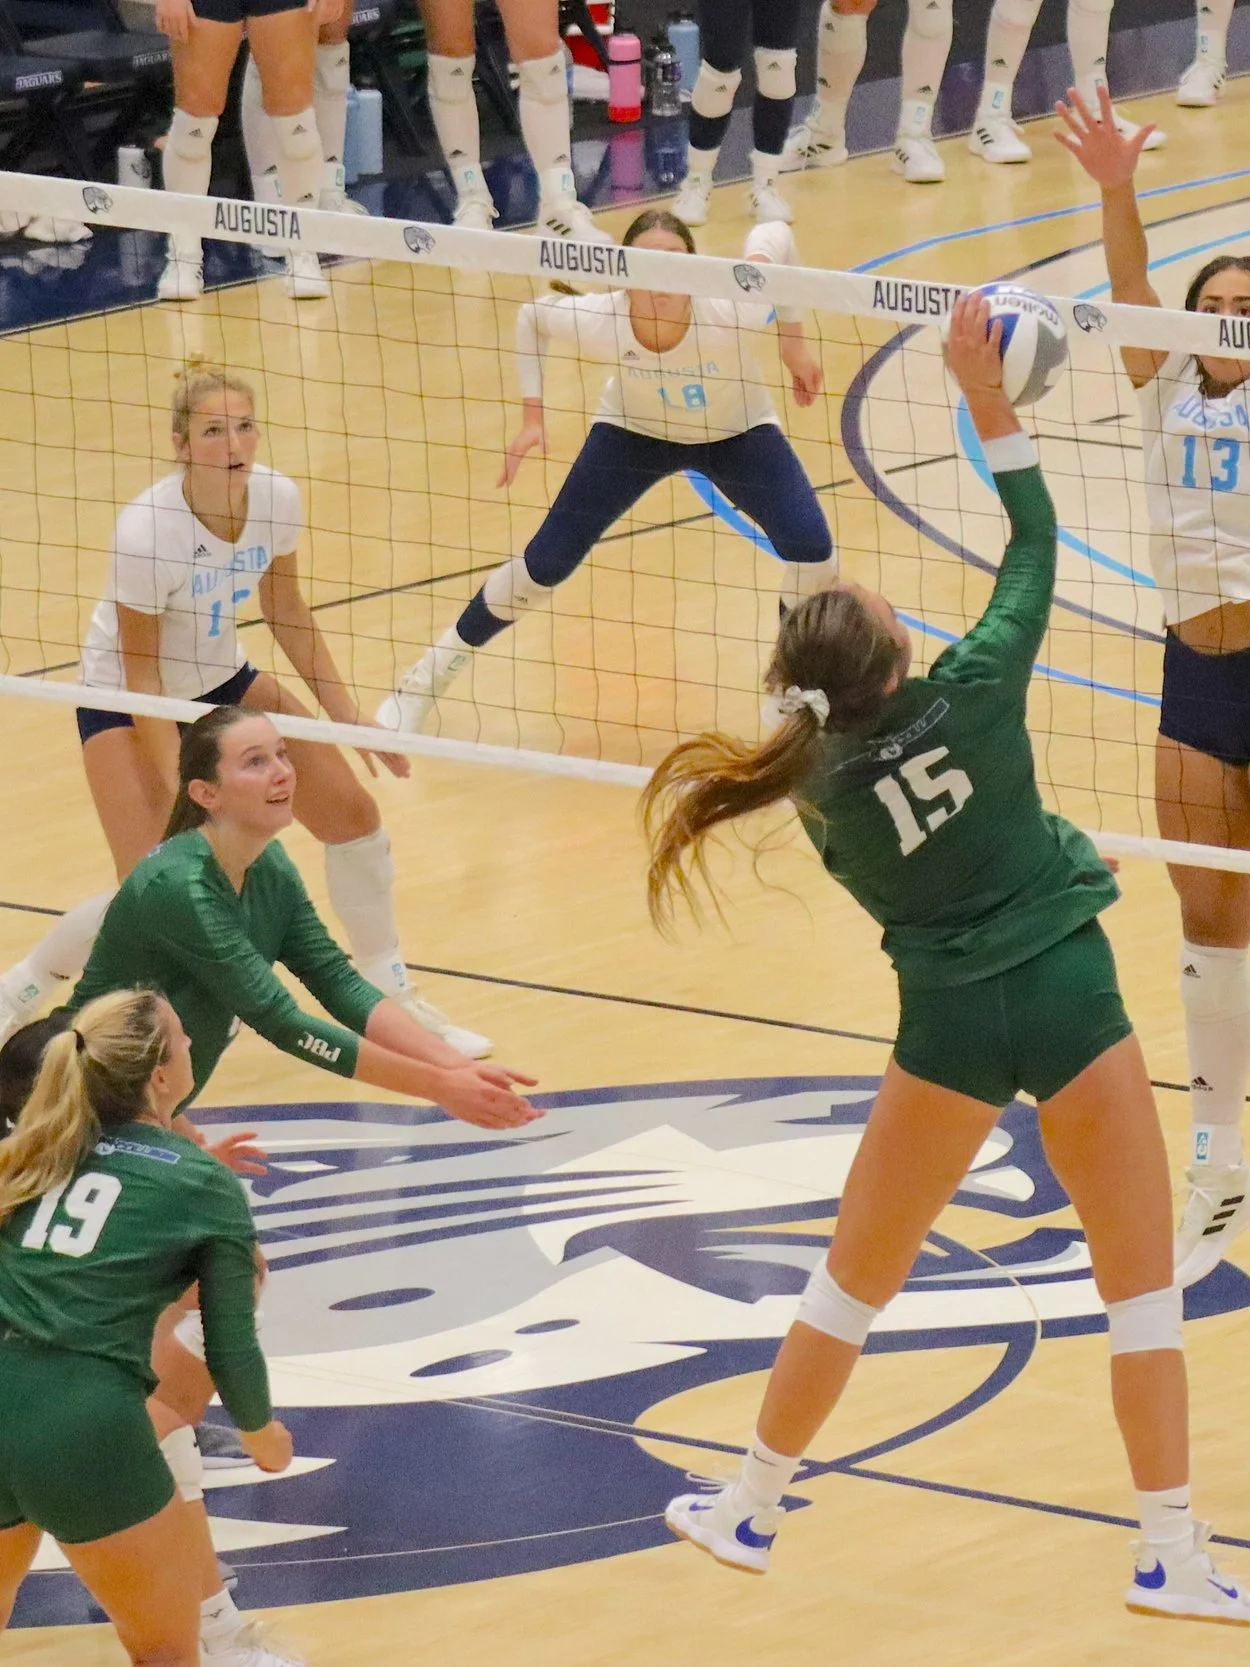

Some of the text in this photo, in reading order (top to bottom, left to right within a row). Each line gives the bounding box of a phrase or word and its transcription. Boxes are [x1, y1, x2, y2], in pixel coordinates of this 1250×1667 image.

[214, 201, 302, 240] AUGUSTA
[539, 240, 629, 278] AUGUSTA
[994, 297, 1058, 326] molten
[656, 383, 706, 409] 18
[1181, 434, 1241, 492] 13
[873, 745, 974, 857] 15
[297, 1031, 341, 1062] PBC
[21, 1172, 123, 1258] 19
